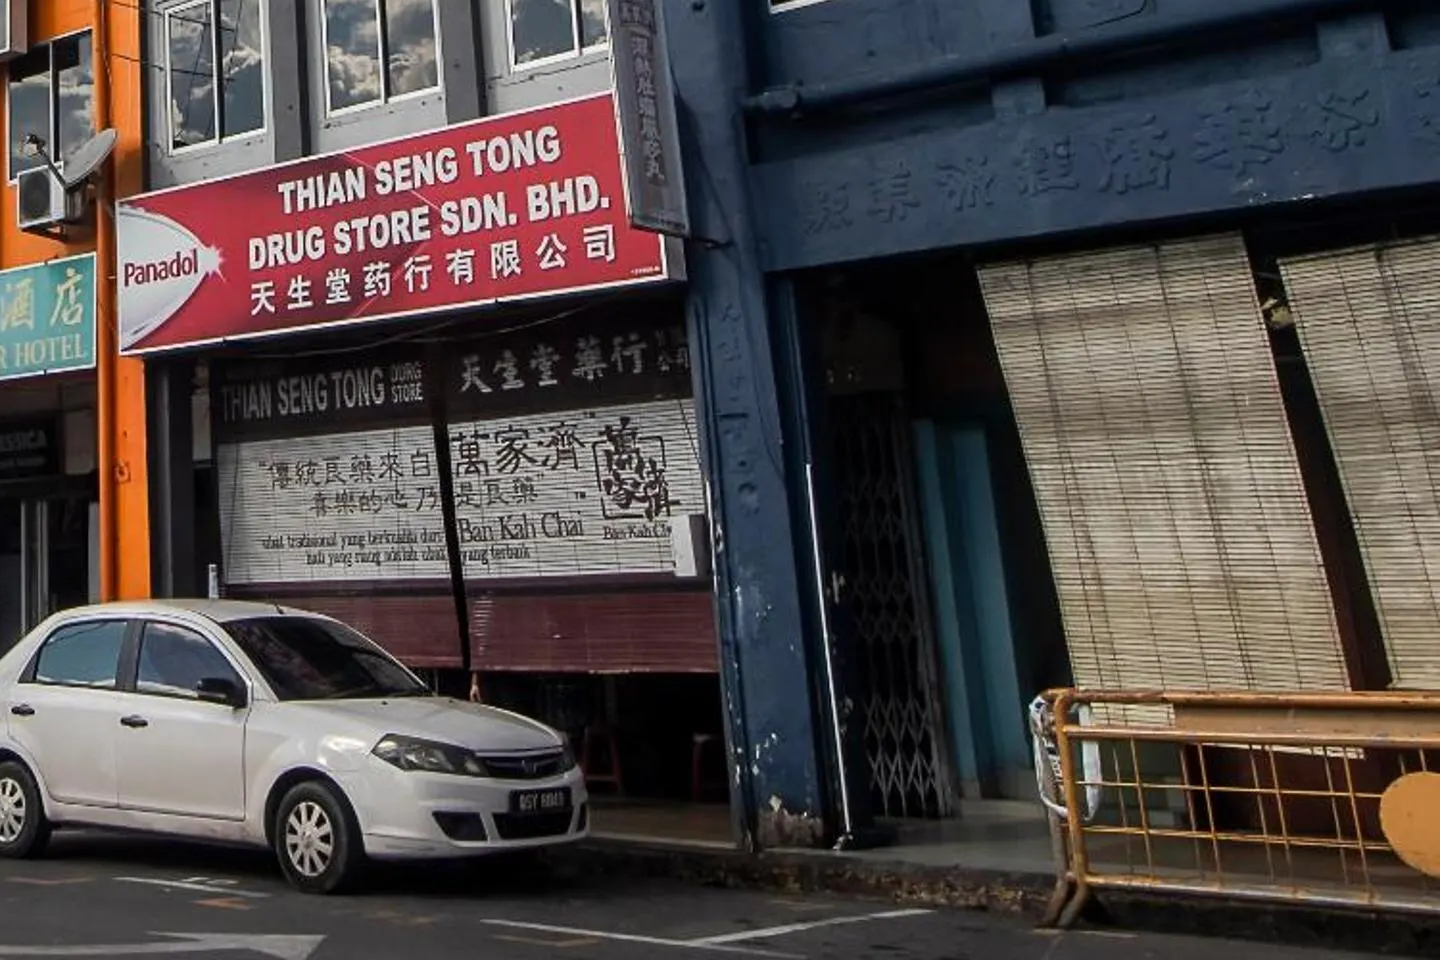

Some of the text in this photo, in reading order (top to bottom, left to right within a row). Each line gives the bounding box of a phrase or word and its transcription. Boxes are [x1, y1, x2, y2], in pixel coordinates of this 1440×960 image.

[278, 125, 561, 214] THIAN SENG TONG
[248, 175, 610, 270] DRUG STORE SDN. BHD.
[124, 248, 198, 287] Panadol
[250, 224, 616, 316] 天生堂药行有限公司
[14, 333, 87, 368] HOTEL
[221, 366, 386, 421] THIAN SENG TONG
[391, 382, 424, 403] STORE
[458, 511, 585, 543] Ban Kah Chai
